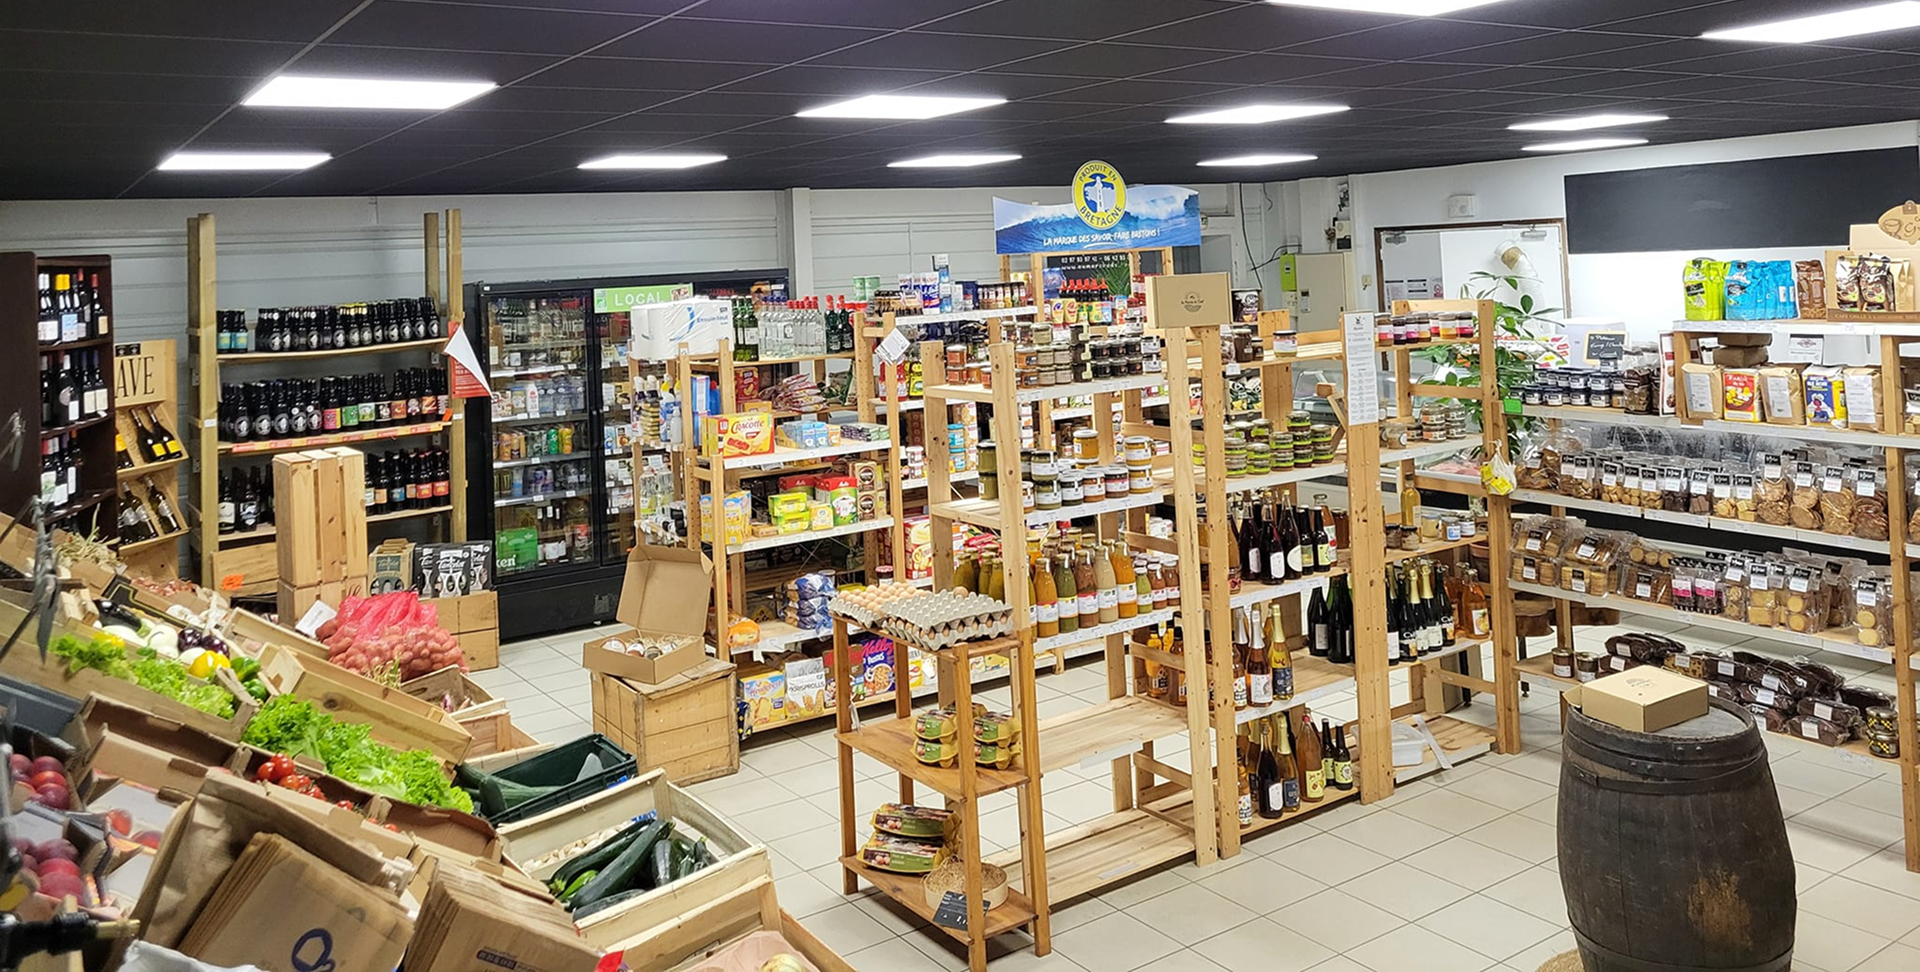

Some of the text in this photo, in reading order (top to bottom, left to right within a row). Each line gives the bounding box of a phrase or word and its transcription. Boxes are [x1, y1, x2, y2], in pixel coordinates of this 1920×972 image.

[1079, 164, 1117, 182] PRODUIT EN
[1080, 204, 1123, 226] BRETAGNE
[1043, 238, 1052, 247] LA
[1053, 235, 1077, 246] MARQUE
[1078, 233, 1091, 243] DES
[1091, 230, 1131, 243] SAVOIR-FAIRE
[1131, 229, 1157, 239] BRETONS
[615, 291, 664, 307] LOCAL
